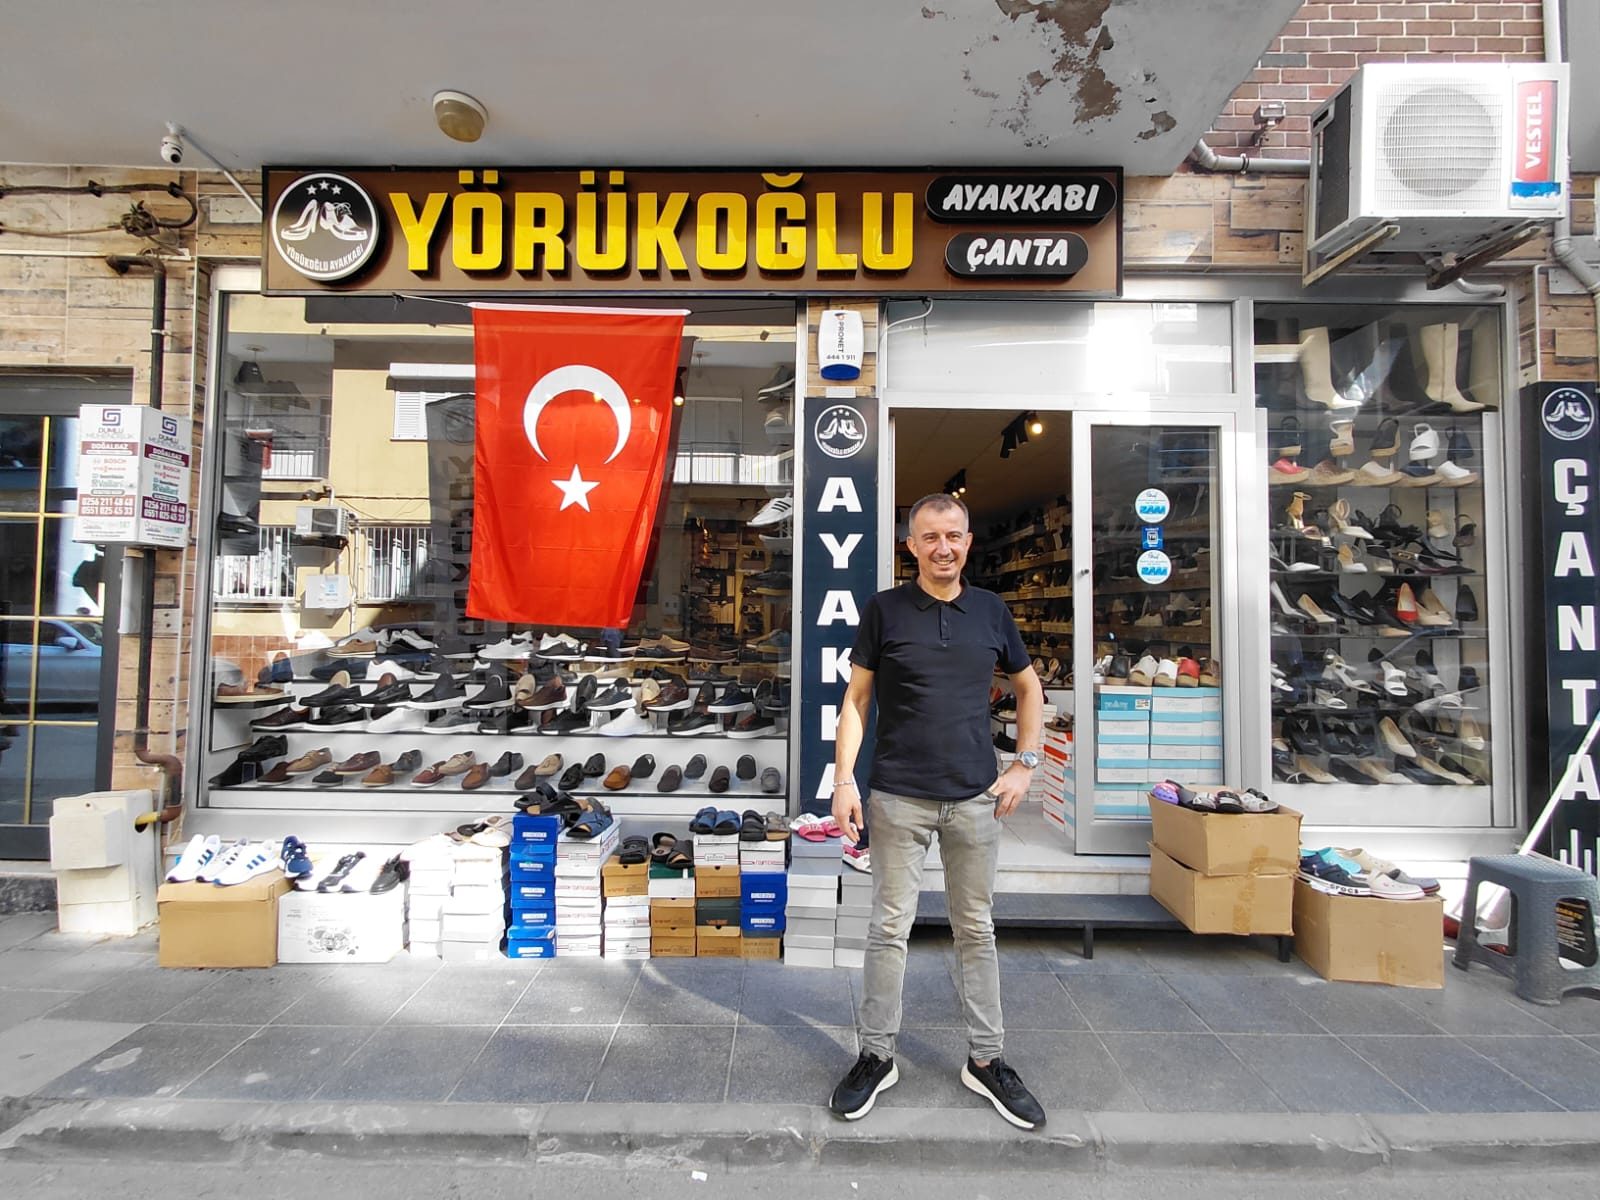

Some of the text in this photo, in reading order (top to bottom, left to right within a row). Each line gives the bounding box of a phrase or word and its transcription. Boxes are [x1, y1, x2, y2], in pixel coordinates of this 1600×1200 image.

[1525, 91, 1541, 169] VESTEL
[942, 184, 1100, 213] AYAKKABI
[389, 170, 914, 271] YÖRÜKOĞLU
[286, 243, 364, 272] YÖRÜKOĞLU AYAKKABI
[966, 237, 1068, 272] ÇANTA
[100, 497, 113, 506] 211
